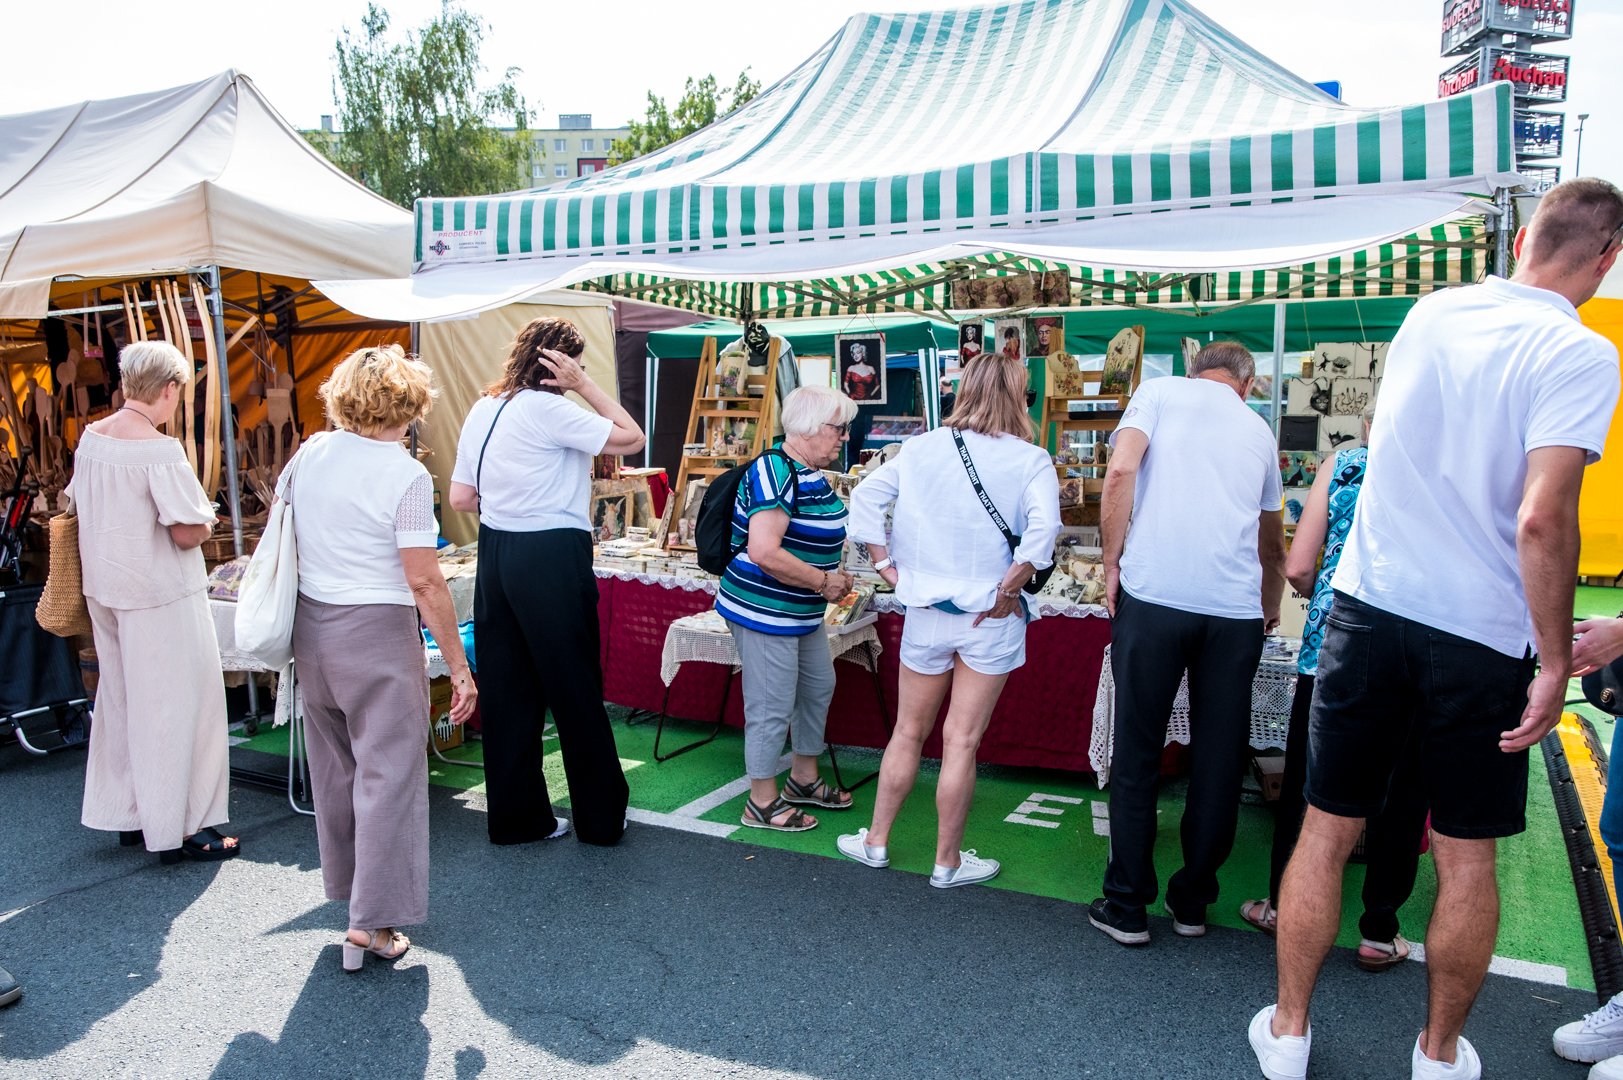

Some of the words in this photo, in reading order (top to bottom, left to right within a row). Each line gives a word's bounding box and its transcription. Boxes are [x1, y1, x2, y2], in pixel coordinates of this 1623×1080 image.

[1492, 58, 1566, 86] Auchan
[438, 230, 483, 238] PRODUCENT
[959, 445, 971, 466] THAT'S
[967, 465, 979, 485] RIGHT
[978, 489, 994, 514] THAT'S
[991, 512, 1008, 531] RIGHT
